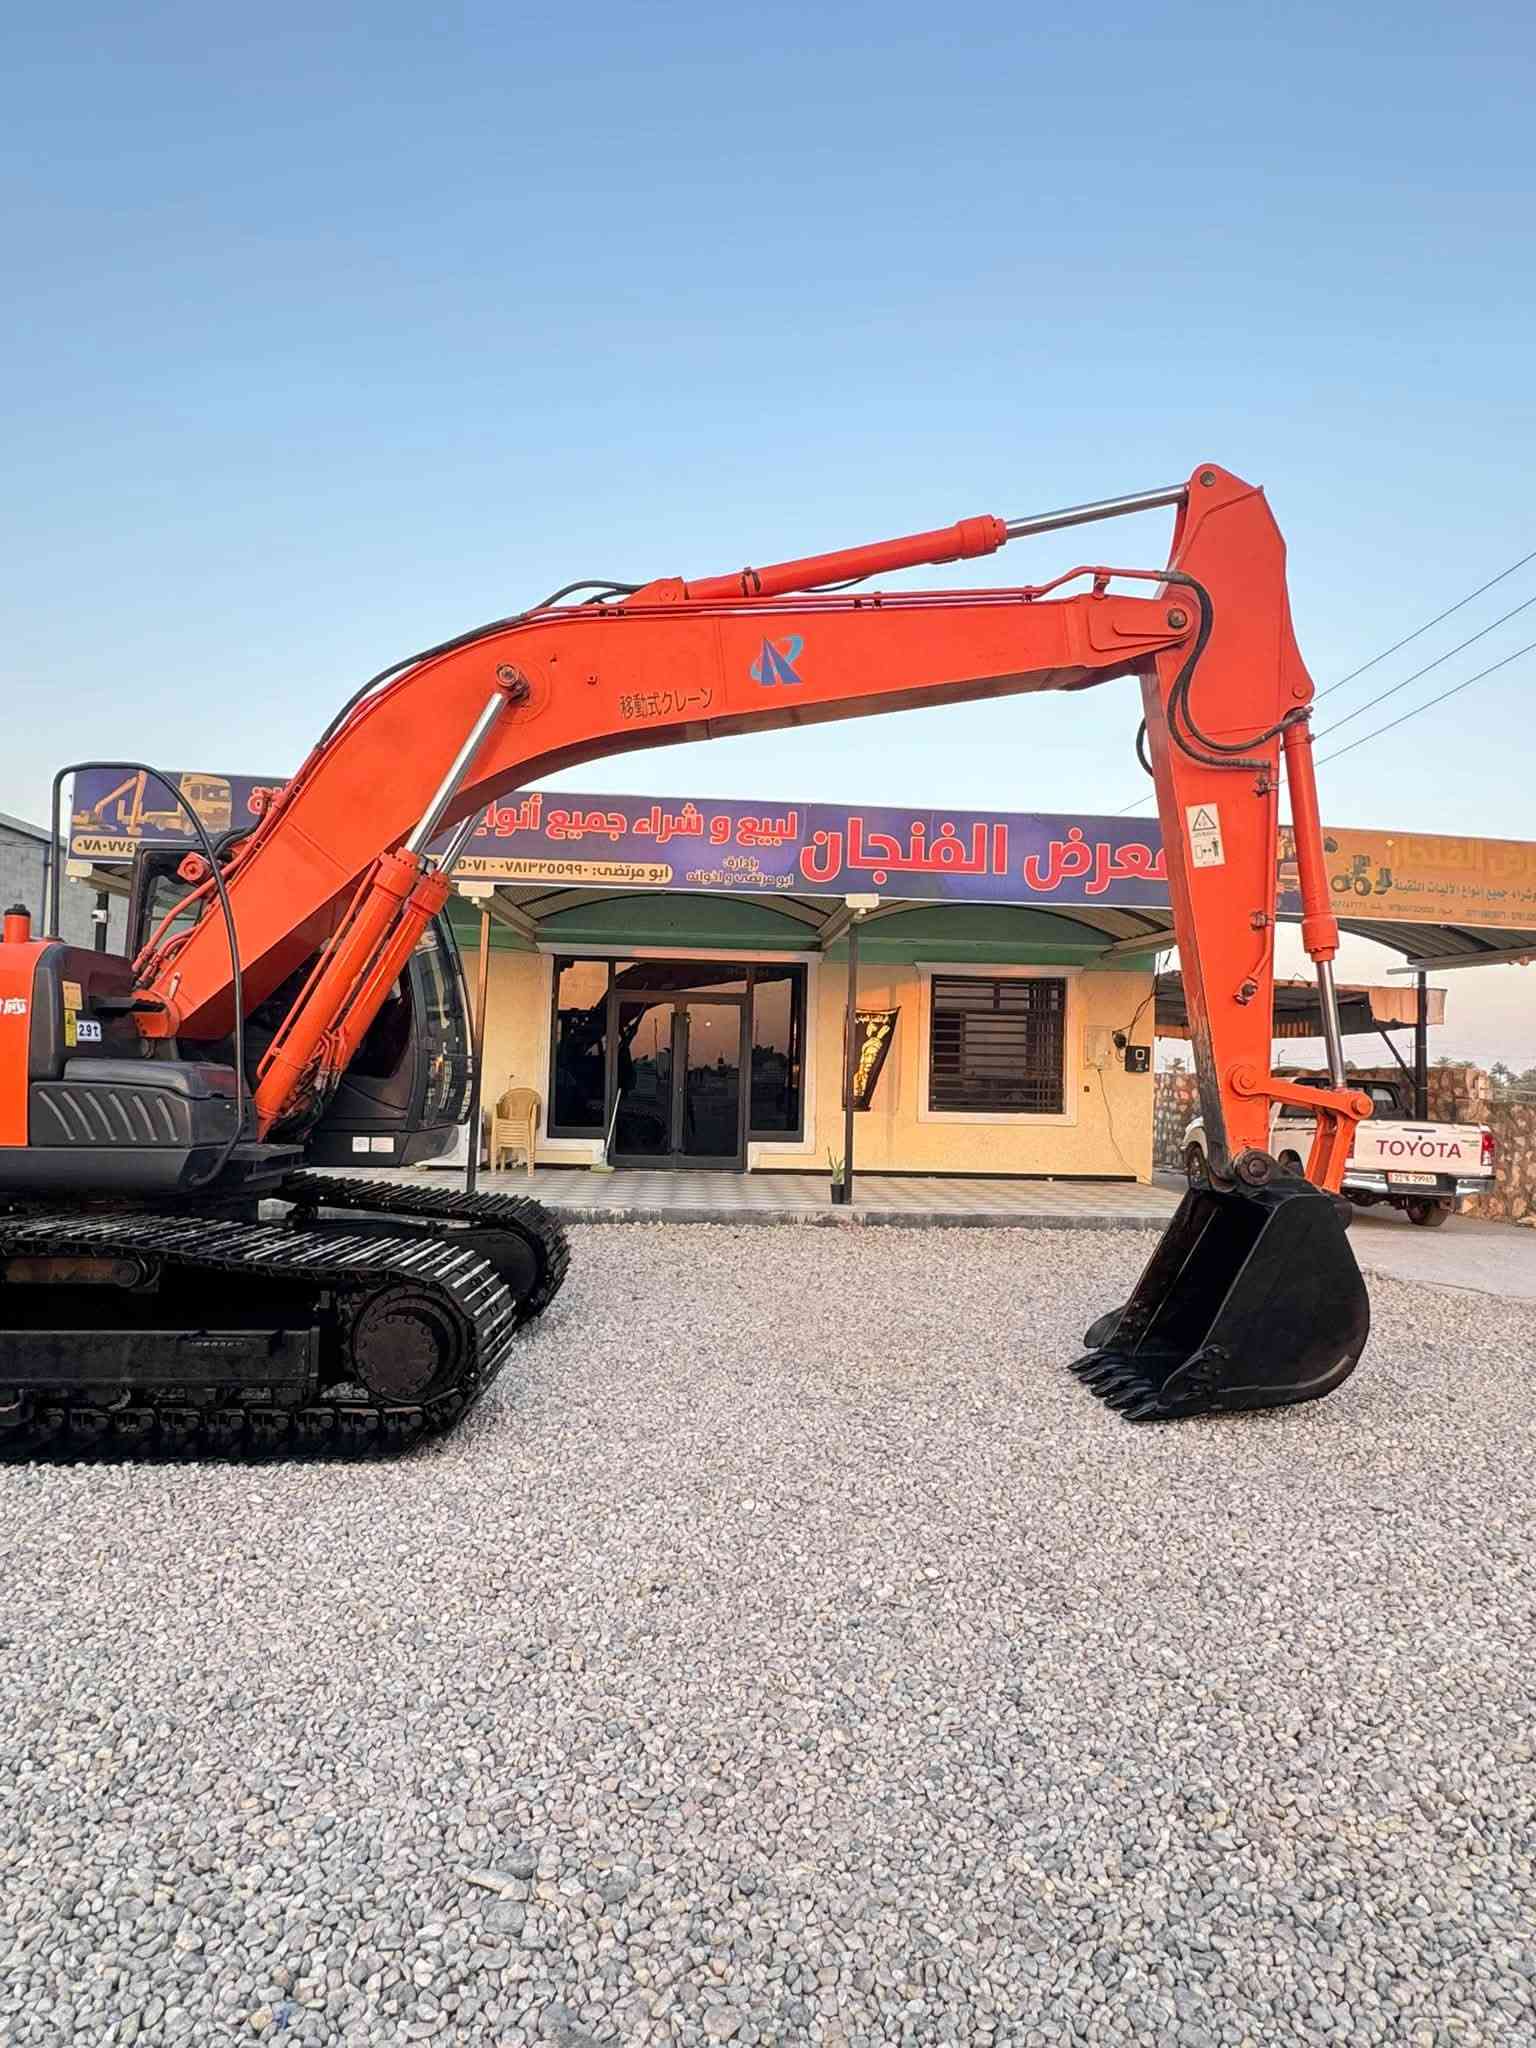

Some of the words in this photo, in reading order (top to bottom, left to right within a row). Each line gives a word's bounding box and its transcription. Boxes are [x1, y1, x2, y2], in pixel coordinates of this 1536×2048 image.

[620, 688, 713, 720] 移動式クレーン
[545, 808, 628, 841] جميع
[632, 802, 704, 844] شراء
[709, 815, 731, 845] و
[736, 811, 798, 847] لبيع
[800, 817, 1008, 885] الفنجان
[1376, 1139, 1462, 1158] TOYOTA
